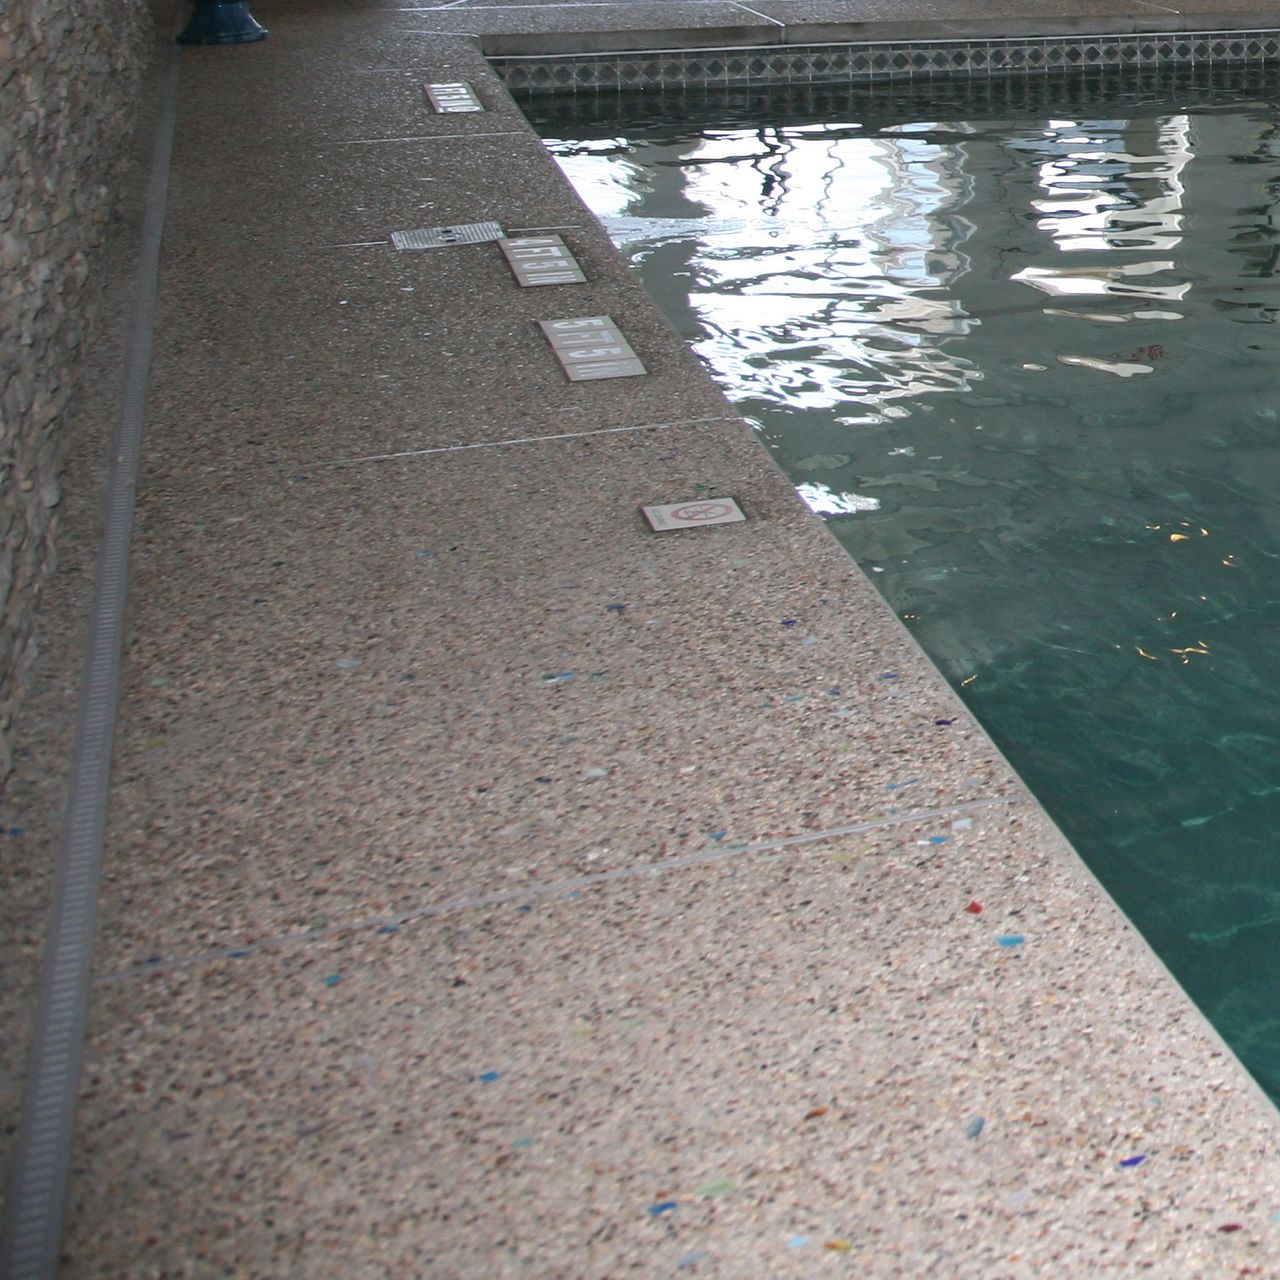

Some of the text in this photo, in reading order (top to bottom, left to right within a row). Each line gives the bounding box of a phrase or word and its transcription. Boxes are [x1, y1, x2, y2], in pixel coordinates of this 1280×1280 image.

[512, 246, 562, 258] FT
[522, 261, 568, 269] 5
[552, 319, 604, 329] 5
[558, 330, 615, 344] FT
[568, 347, 623, 358] 5
